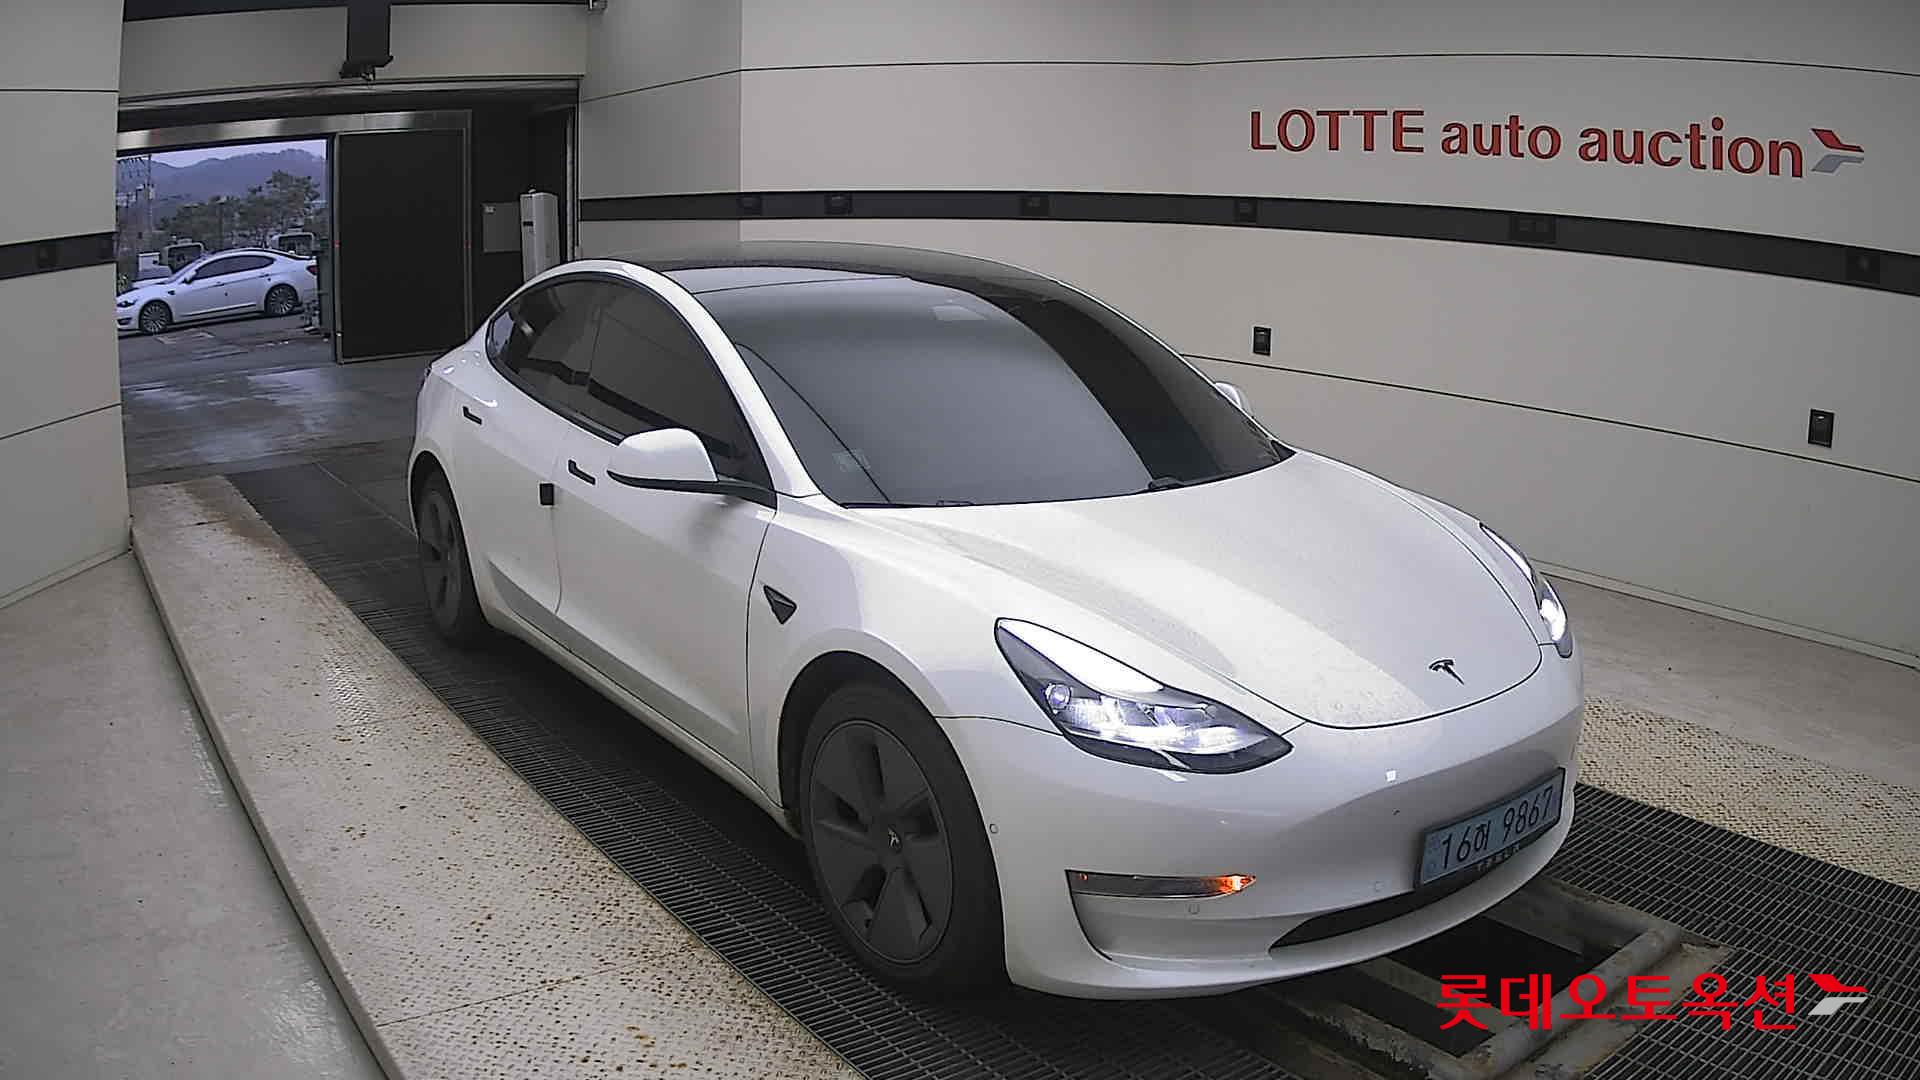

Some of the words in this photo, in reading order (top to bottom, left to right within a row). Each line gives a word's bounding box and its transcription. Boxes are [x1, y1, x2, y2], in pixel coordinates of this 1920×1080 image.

[1249, 109, 1425, 154] LOTTE
[1440, 114, 1562, 161] auto
[1577, 116, 1805, 179] auction
[1441, 820, 1492, 870] 16허
[1503, 785, 1554, 843] 9867
